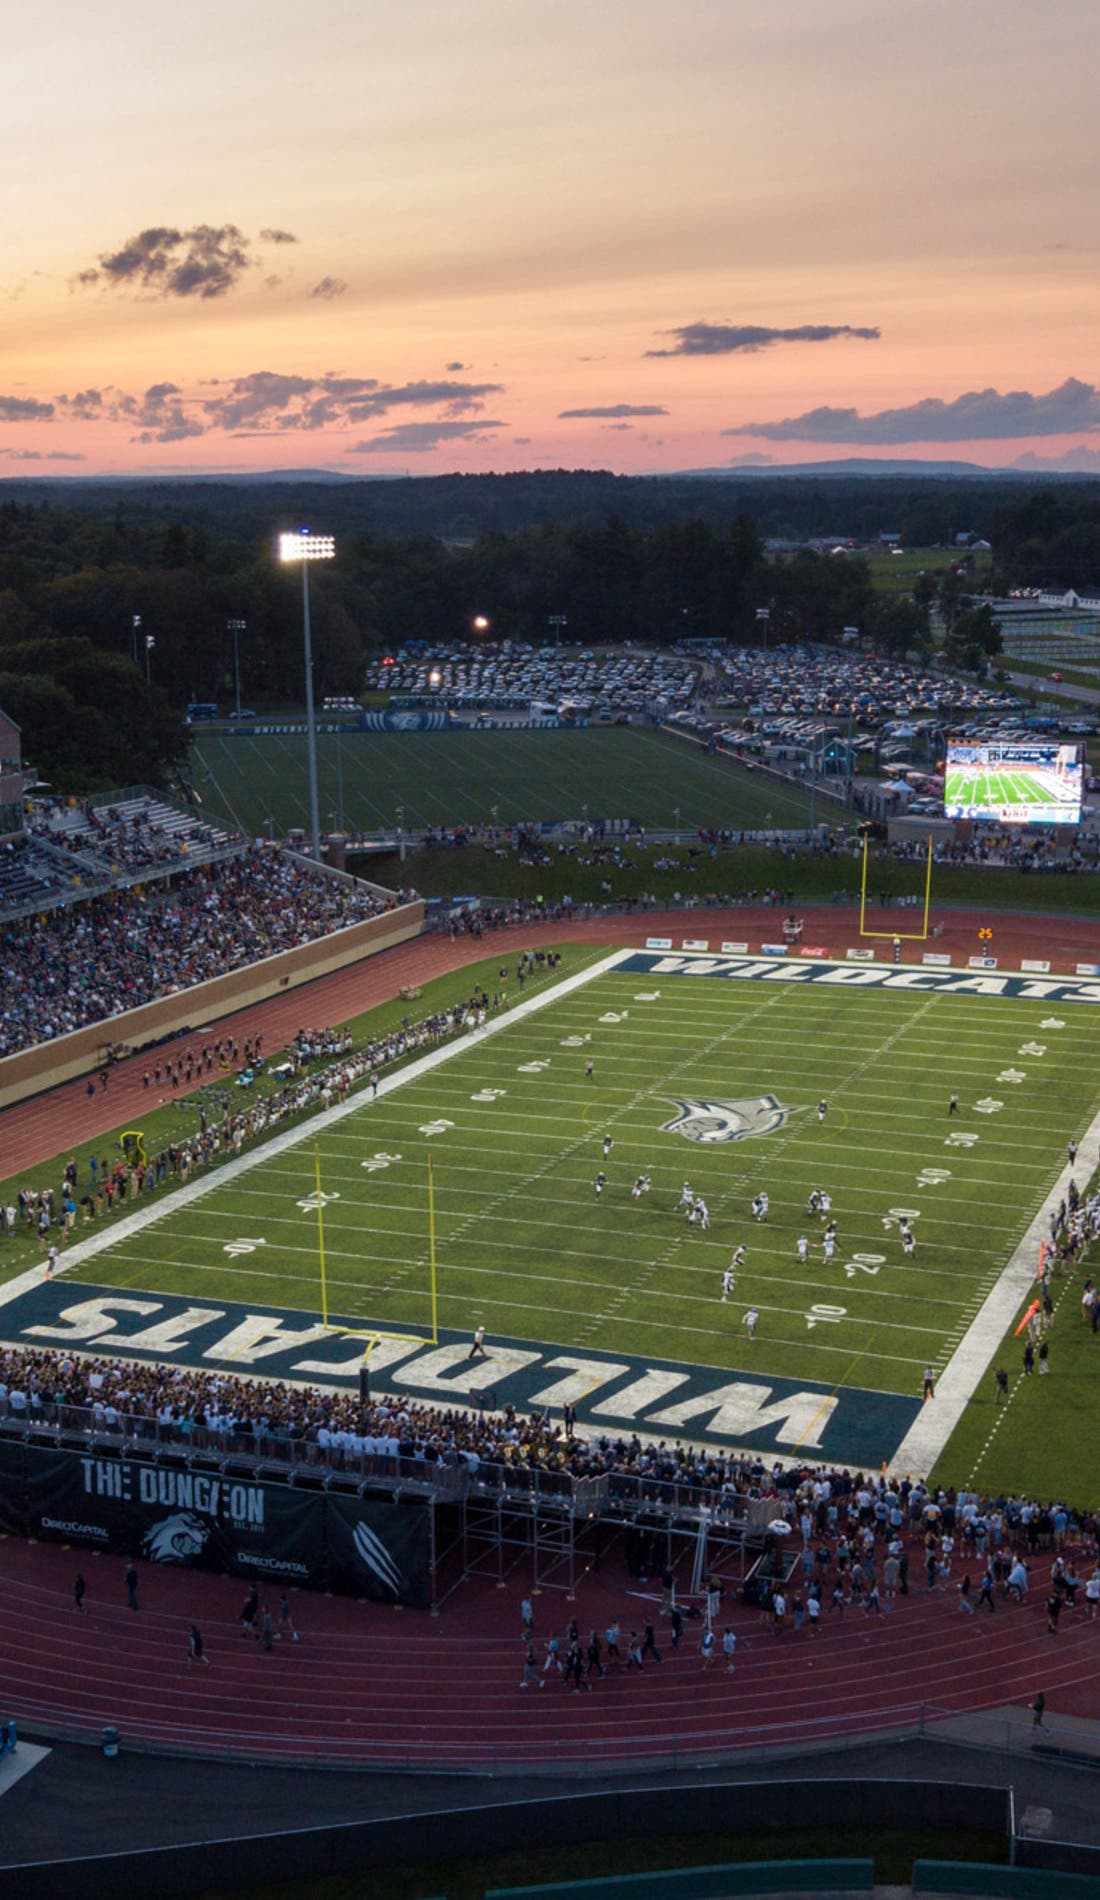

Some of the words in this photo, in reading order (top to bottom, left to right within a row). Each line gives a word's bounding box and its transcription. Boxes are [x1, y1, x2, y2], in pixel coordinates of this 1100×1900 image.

[978, 928, 993, 940] 25
[844, 1253, 887, 1275] 20
[804, 1304, 848, 1323] 10
[20, 1297, 839, 1448] WILDCATS
[80, 1458, 131, 1500] THE
[139, 1468, 265, 1524] DUNGEON
